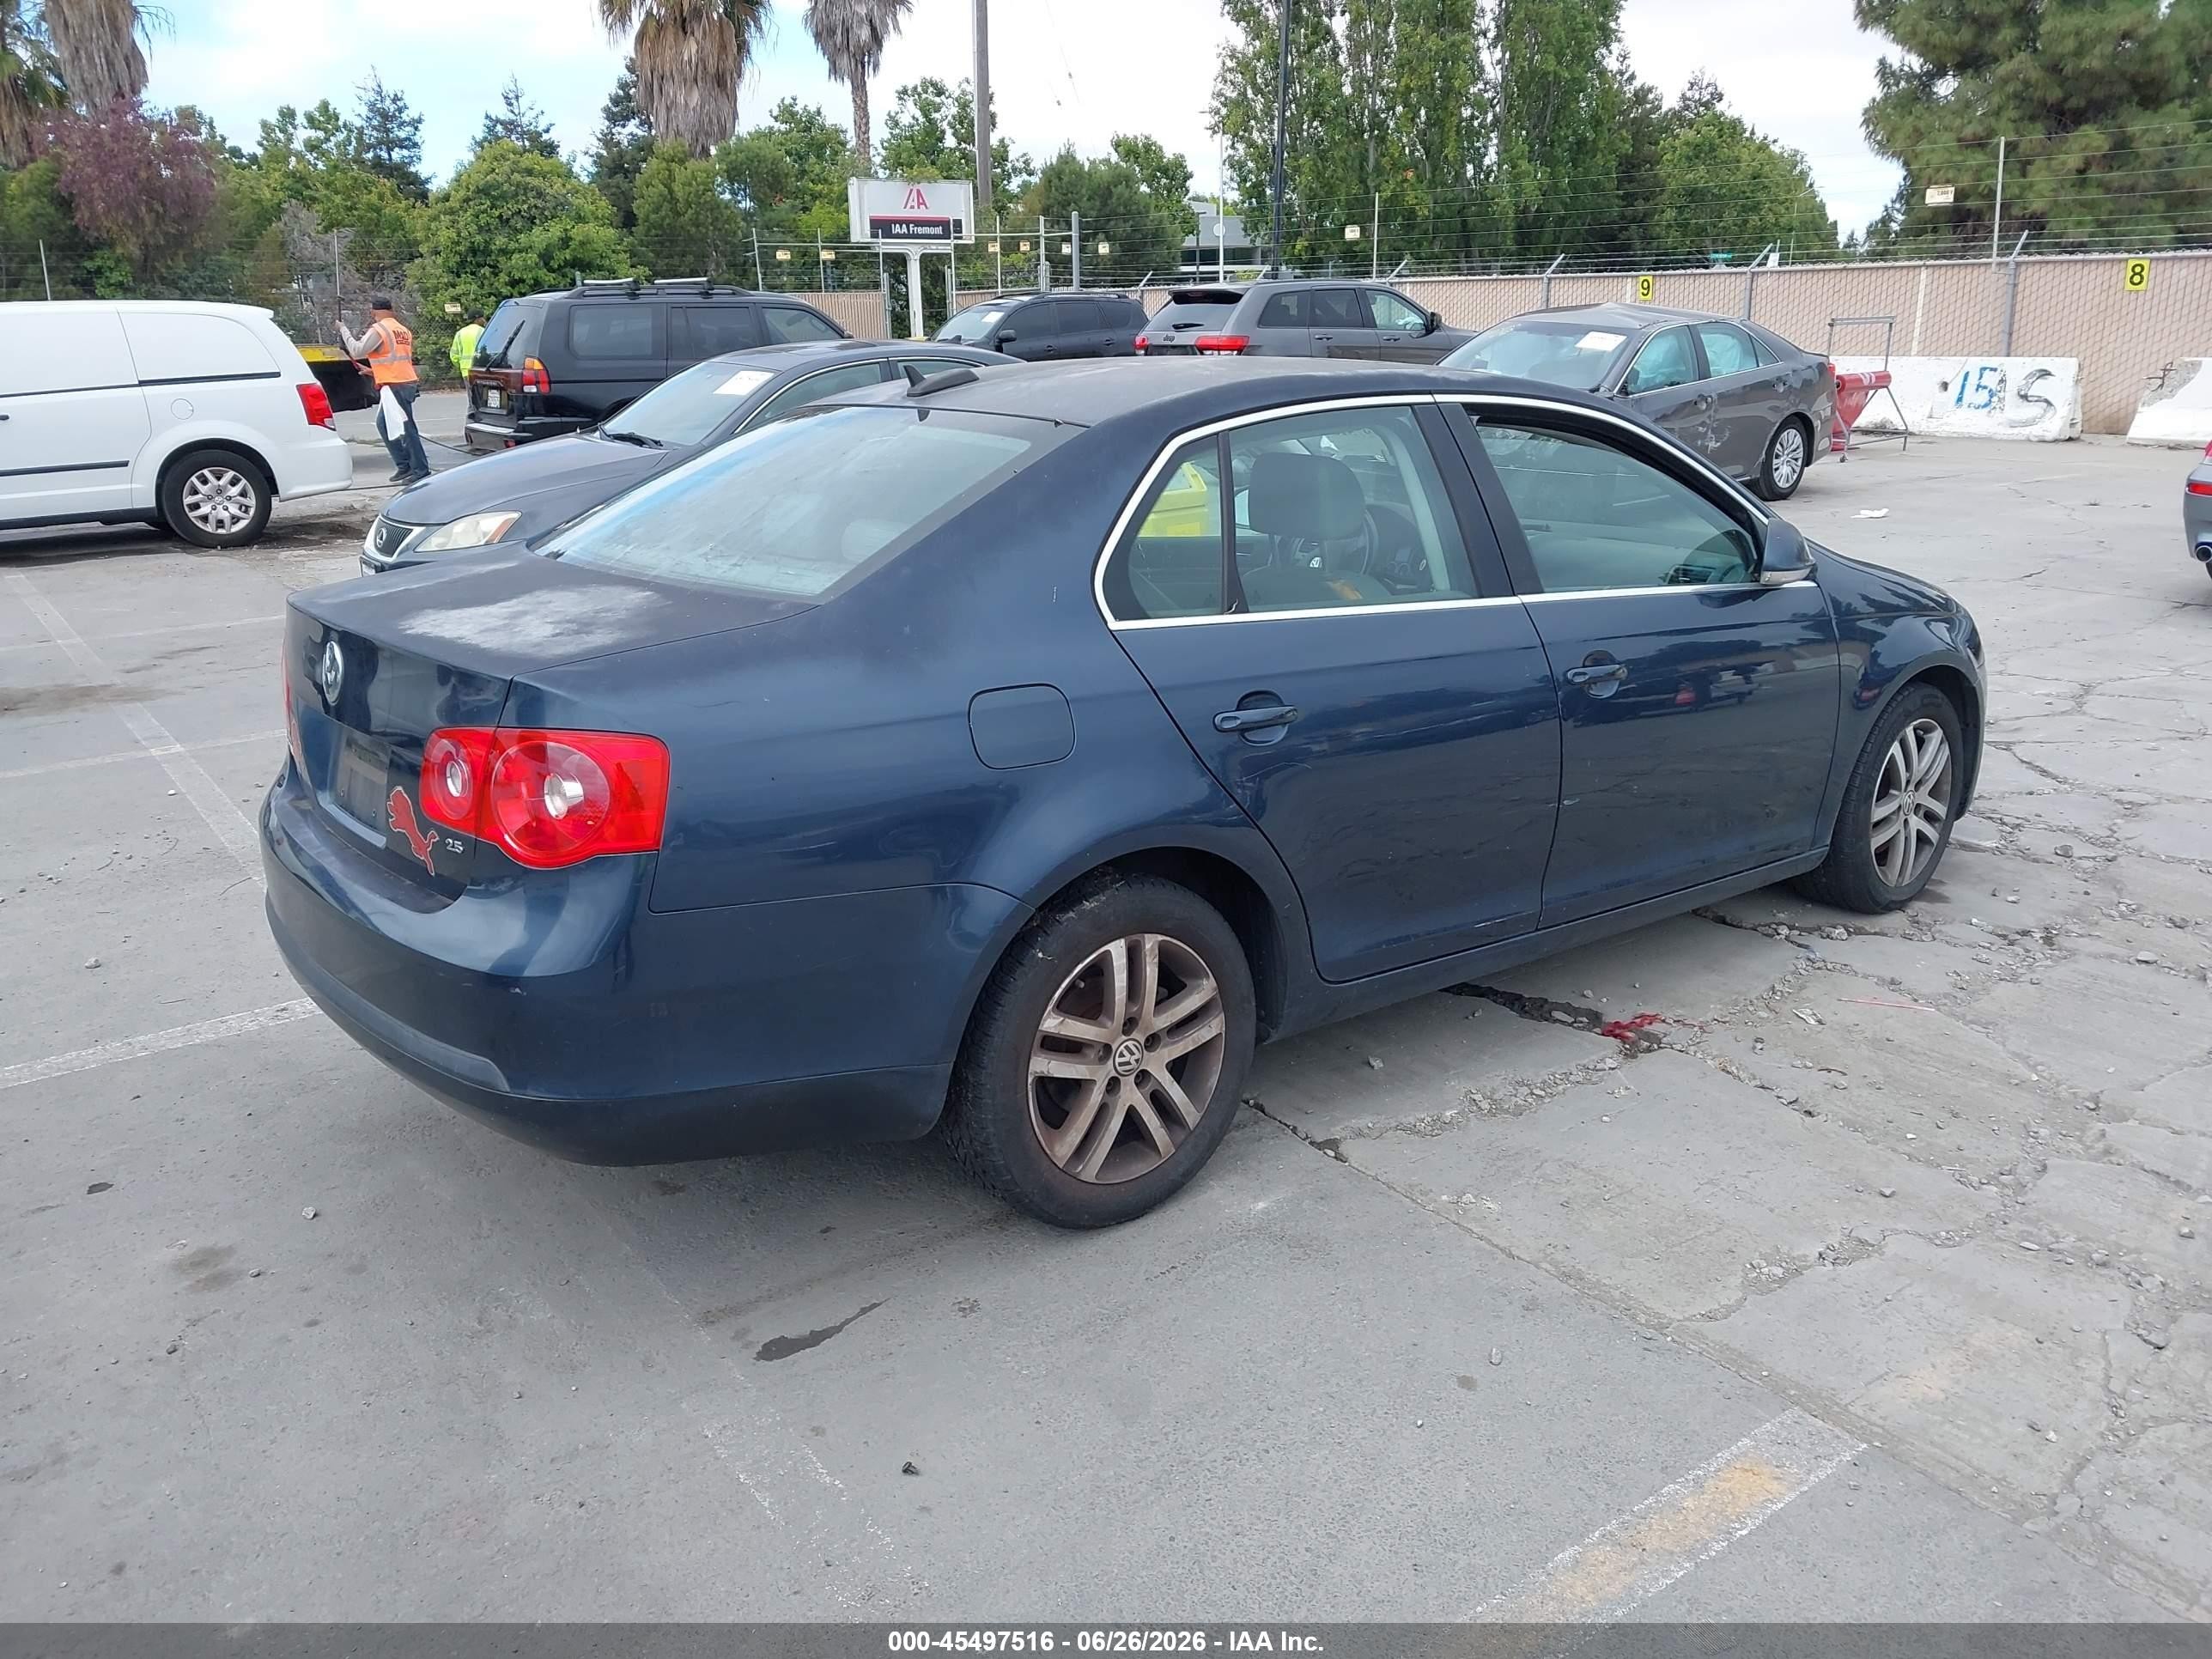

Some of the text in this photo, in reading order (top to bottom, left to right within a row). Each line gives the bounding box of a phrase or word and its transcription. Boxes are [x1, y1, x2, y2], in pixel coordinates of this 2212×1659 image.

[891, 223, 944, 234] IAA Fremont
[2129, 263, 2145, 286] 8
[1641, 278, 1650, 296] 9
